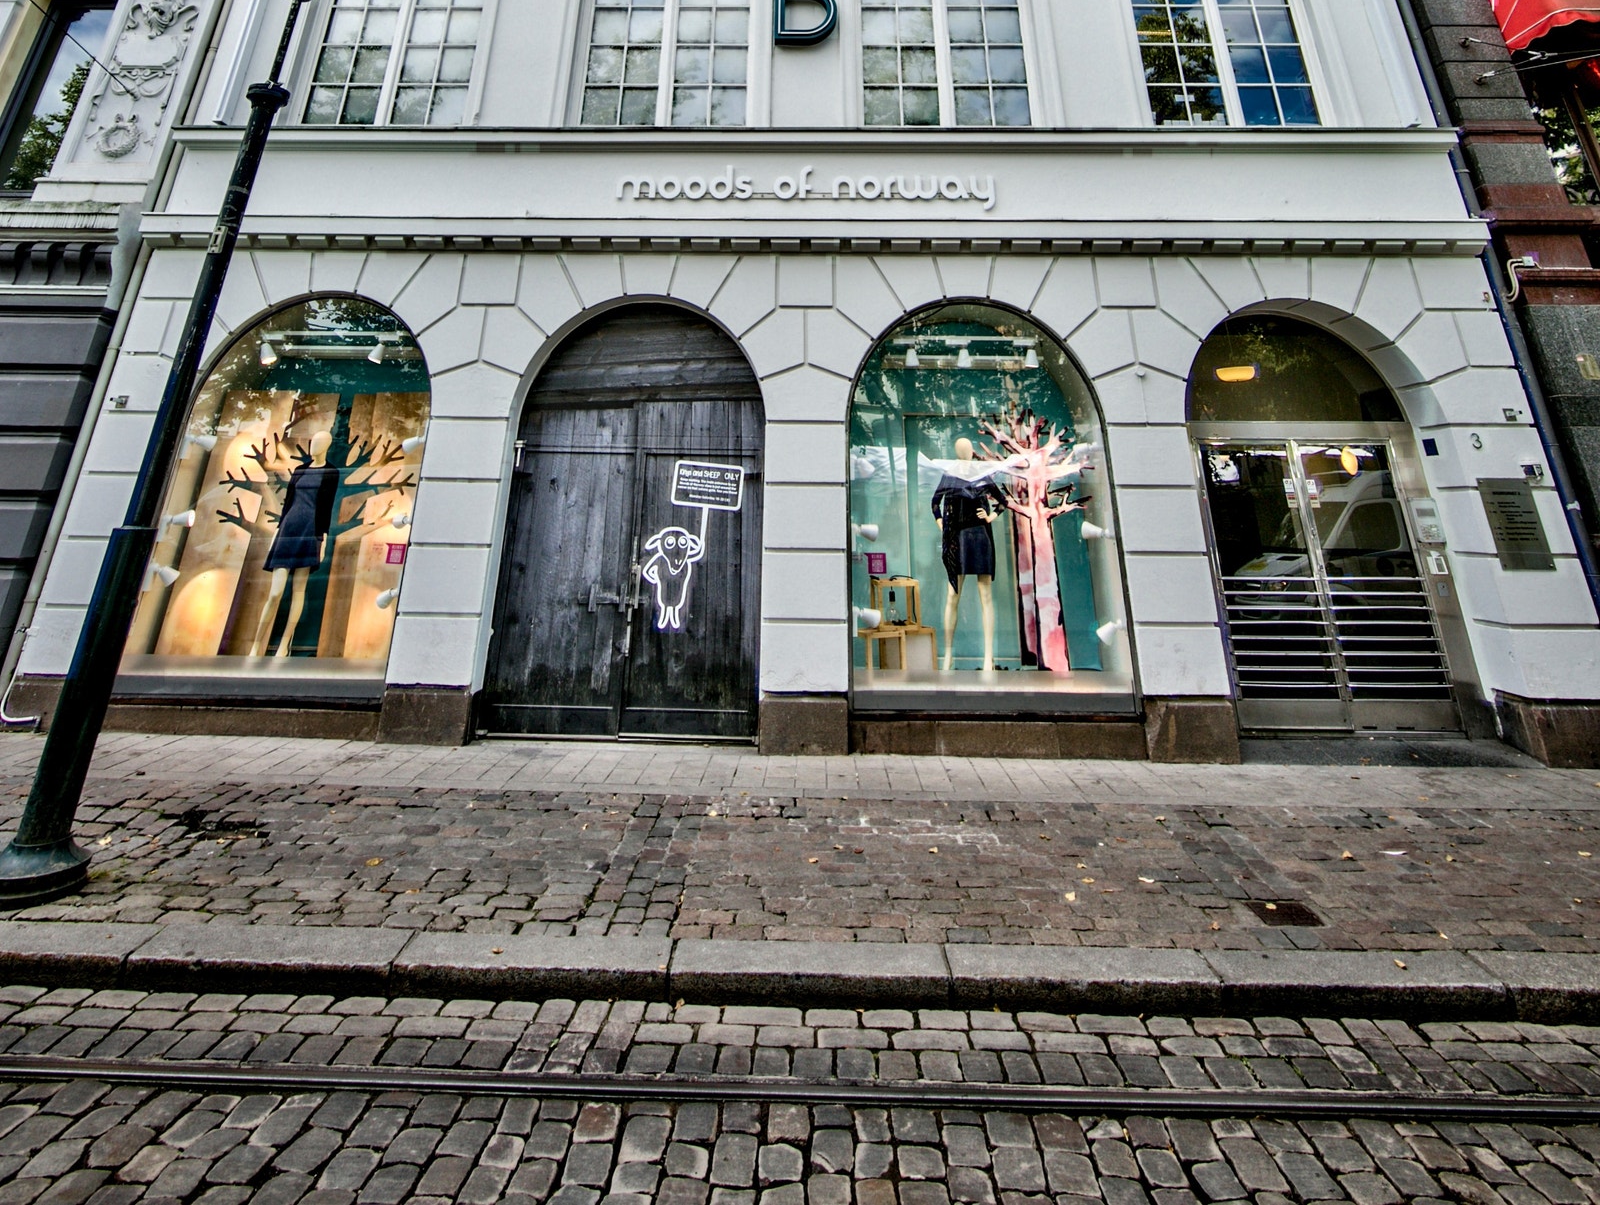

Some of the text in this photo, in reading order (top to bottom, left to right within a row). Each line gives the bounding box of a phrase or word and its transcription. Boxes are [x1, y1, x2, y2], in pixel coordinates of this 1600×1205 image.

[616, 165, 997, 211] moods of norway
[1470, 432, 1483, 450] 3
[724, 472, 740, 481] ONLY
